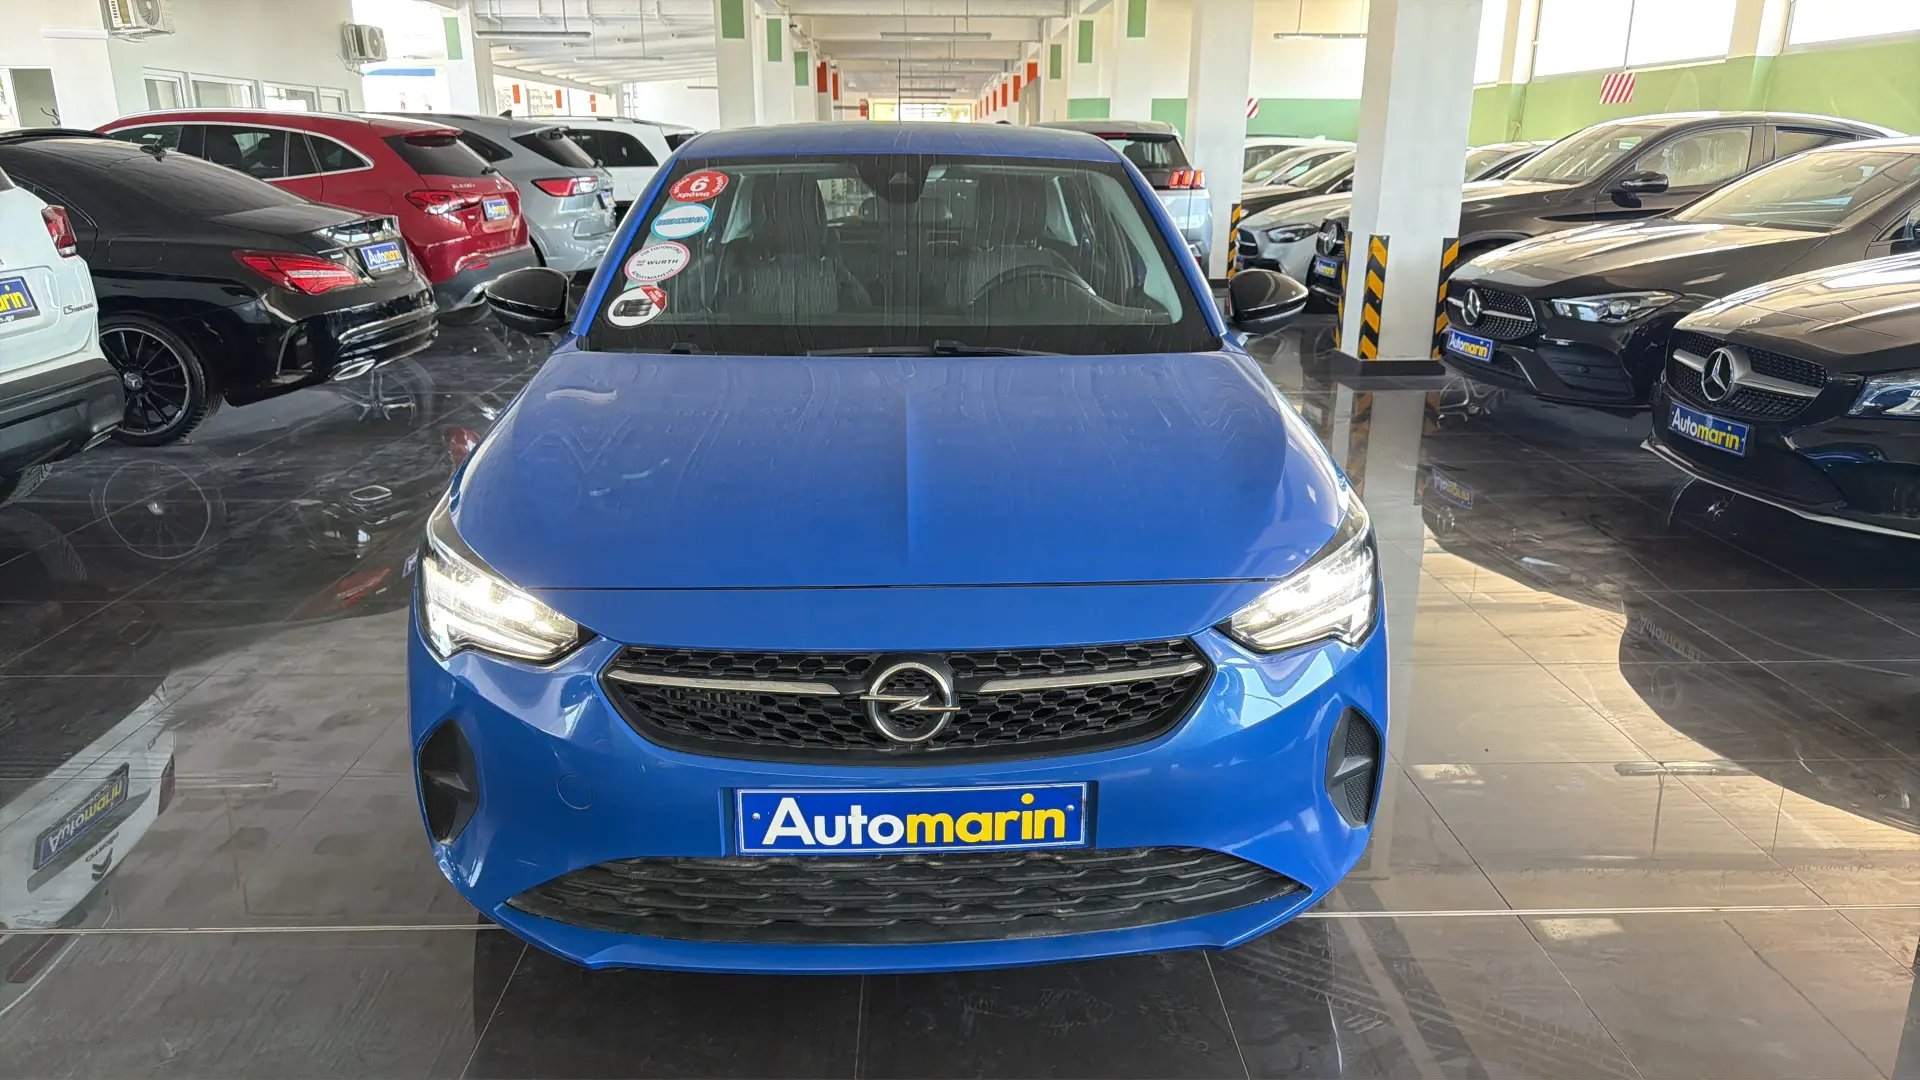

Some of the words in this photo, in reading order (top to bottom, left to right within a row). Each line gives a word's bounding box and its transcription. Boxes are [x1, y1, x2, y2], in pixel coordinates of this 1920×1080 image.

[690, 178, 710, 192] 6
[1449, 332, 1488, 357] Automarin
[1671, 407, 1740, 450] Automarin
[761, 792, 1065, 845] Automarin
